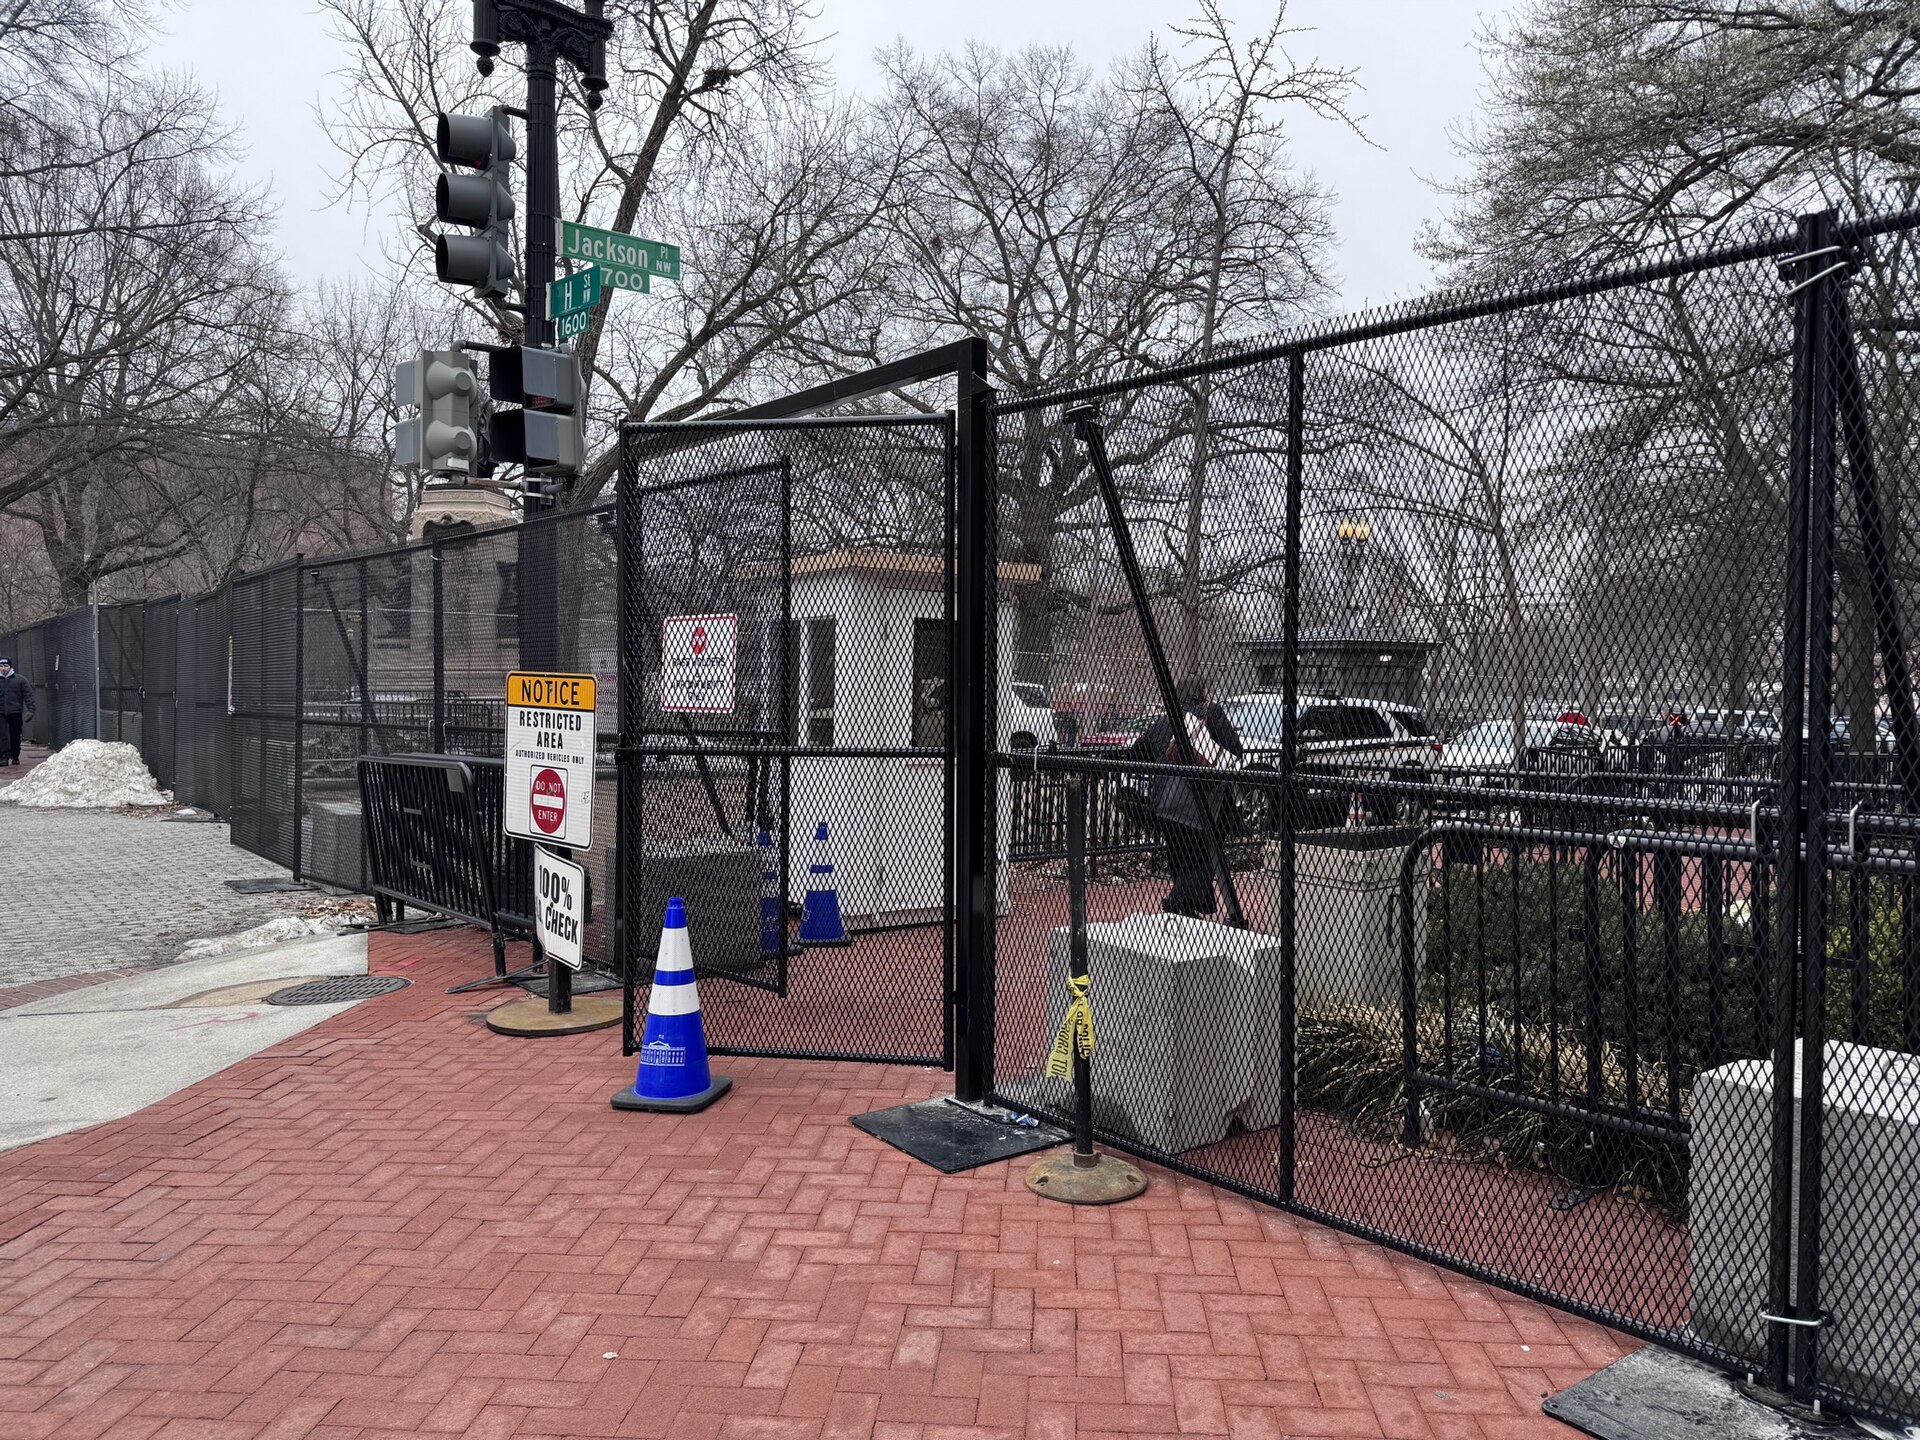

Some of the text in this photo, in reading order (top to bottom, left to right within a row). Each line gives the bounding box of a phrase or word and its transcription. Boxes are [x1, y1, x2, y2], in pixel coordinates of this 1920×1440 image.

[568, 229, 668, 268] Jackson Pl
[656, 260, 672, 273] NW
[601, 267, 643, 290] 700
[564, 273, 591, 310] H St
[583, 288, 591, 302] NW
[561, 311, 587, 336] 1600
[521, 679, 580, 706] NOTICE
[519, 710, 582, 732] RESTRICTED
[536, 731, 564, 750] AREA
[515, 749, 584, 764] AUTHORIZED VEHICLES ONLY
[536, 780, 561, 793] DO NOT
[537, 809, 558, 823] ENTER
[539, 864, 572, 911] 100%
[545, 905, 578, 945] CHECK
